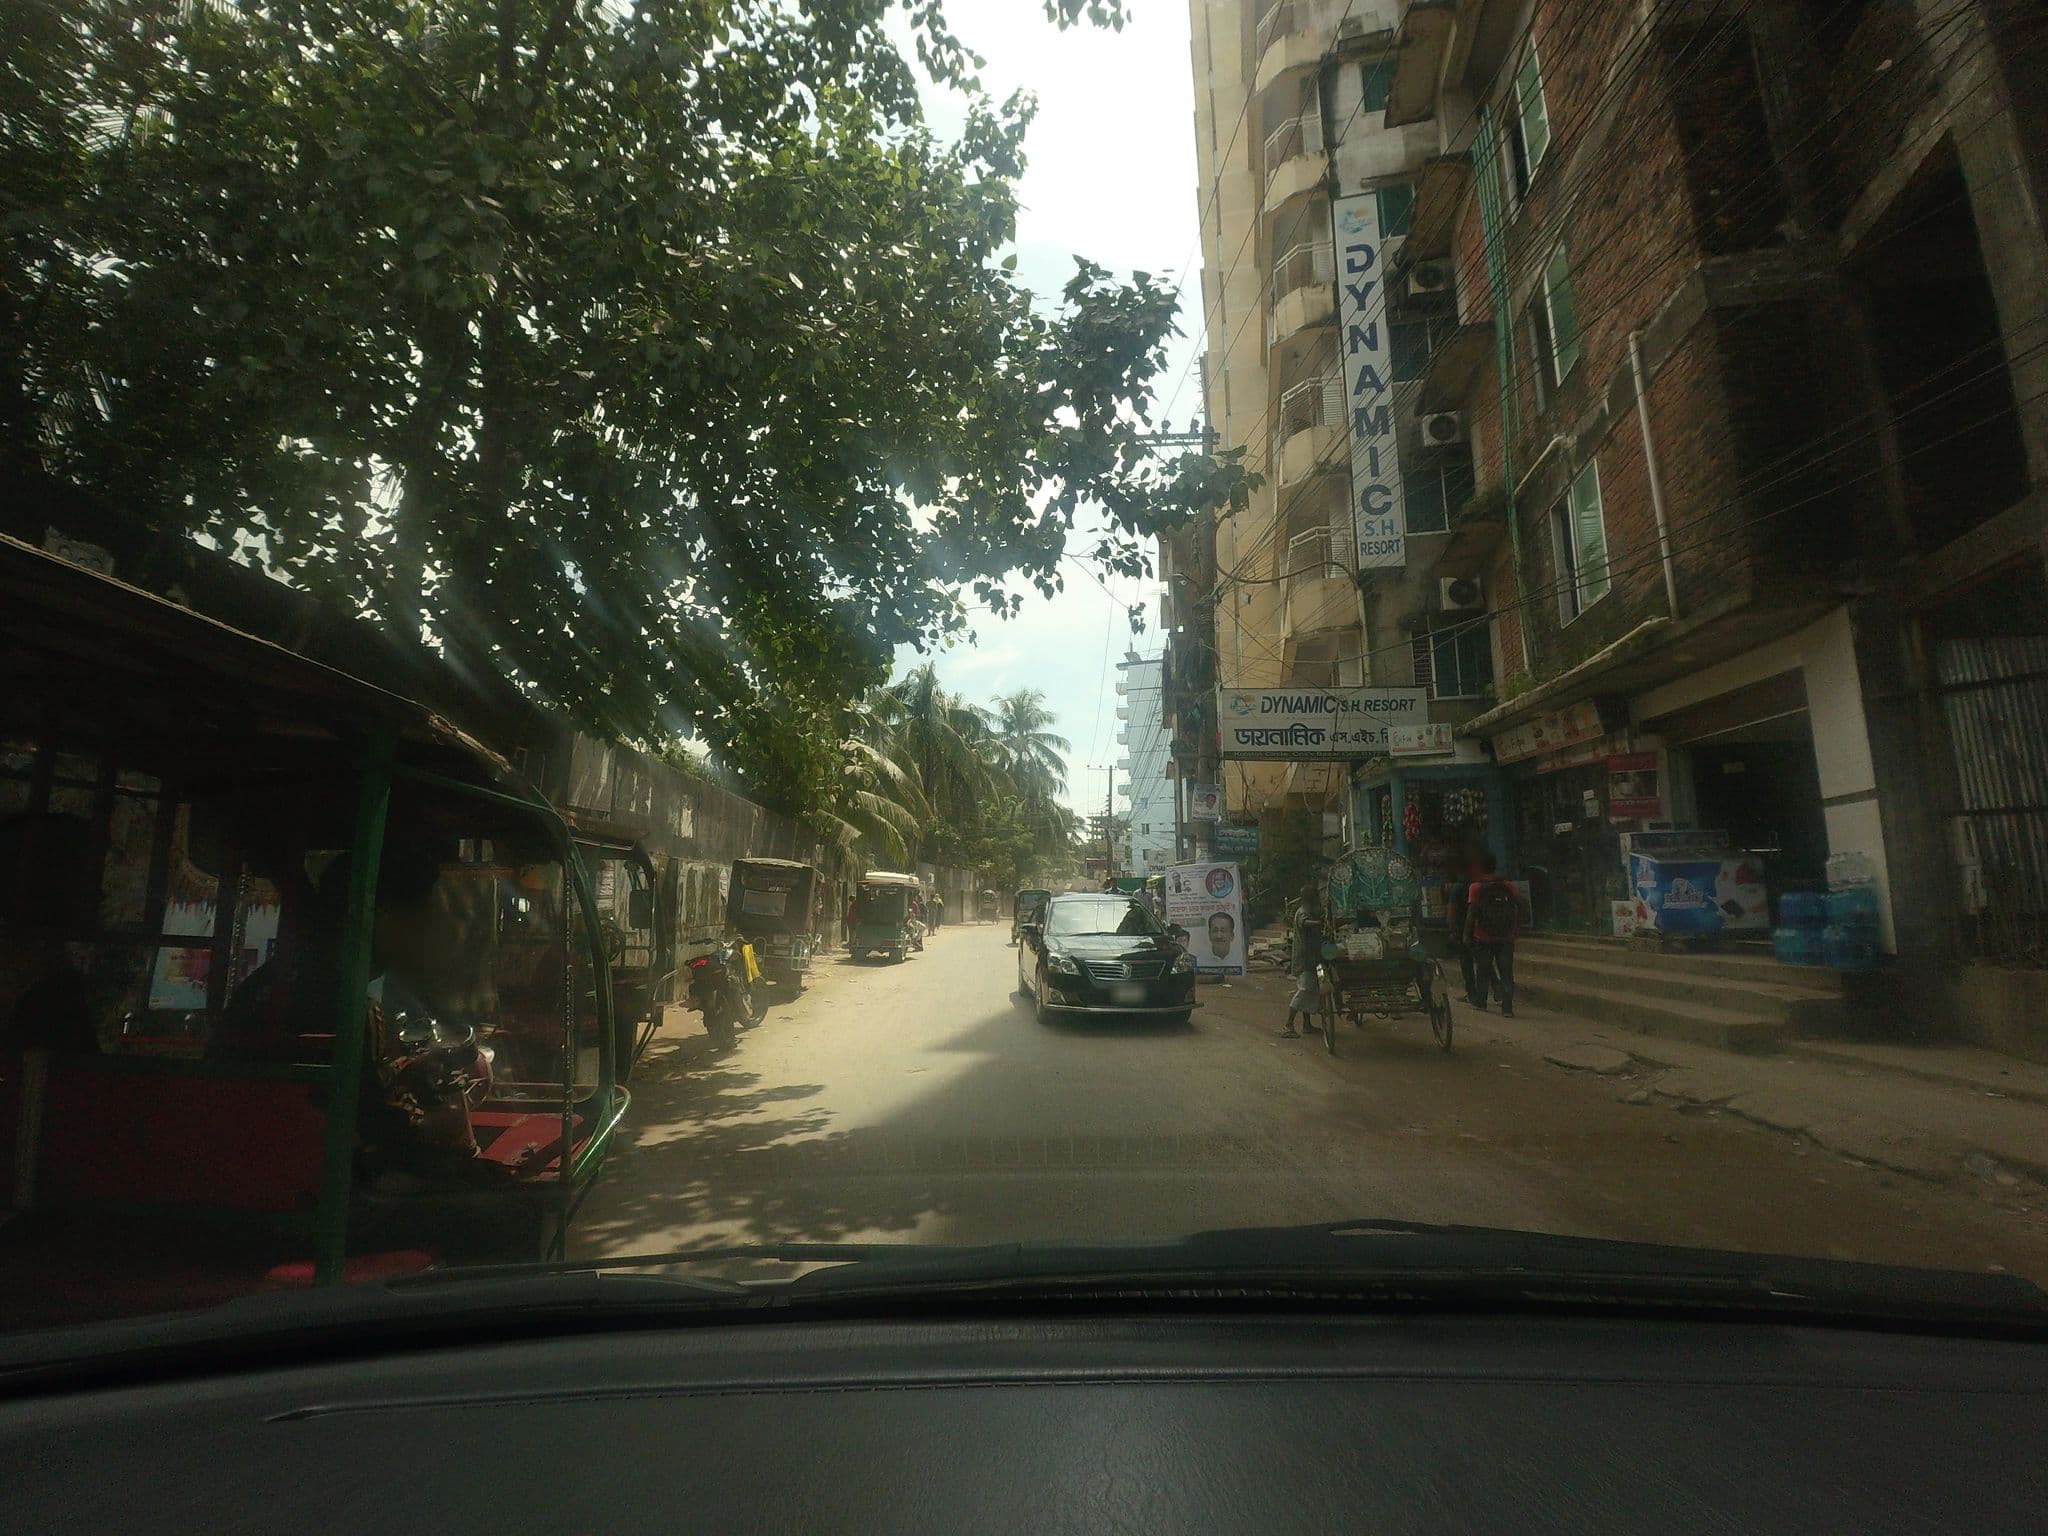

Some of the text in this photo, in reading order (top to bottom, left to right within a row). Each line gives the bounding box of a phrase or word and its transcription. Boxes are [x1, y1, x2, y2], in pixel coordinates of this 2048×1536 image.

[1344, 244, 1393, 516] DYNAMIC
[1360, 539, 1400, 555] RESORT
[1261, 695, 1335, 714] DYNAMIC
[1364, 698, 1416, 712] RESORT
[1234, 722, 1326, 747] ডায়নামিক
